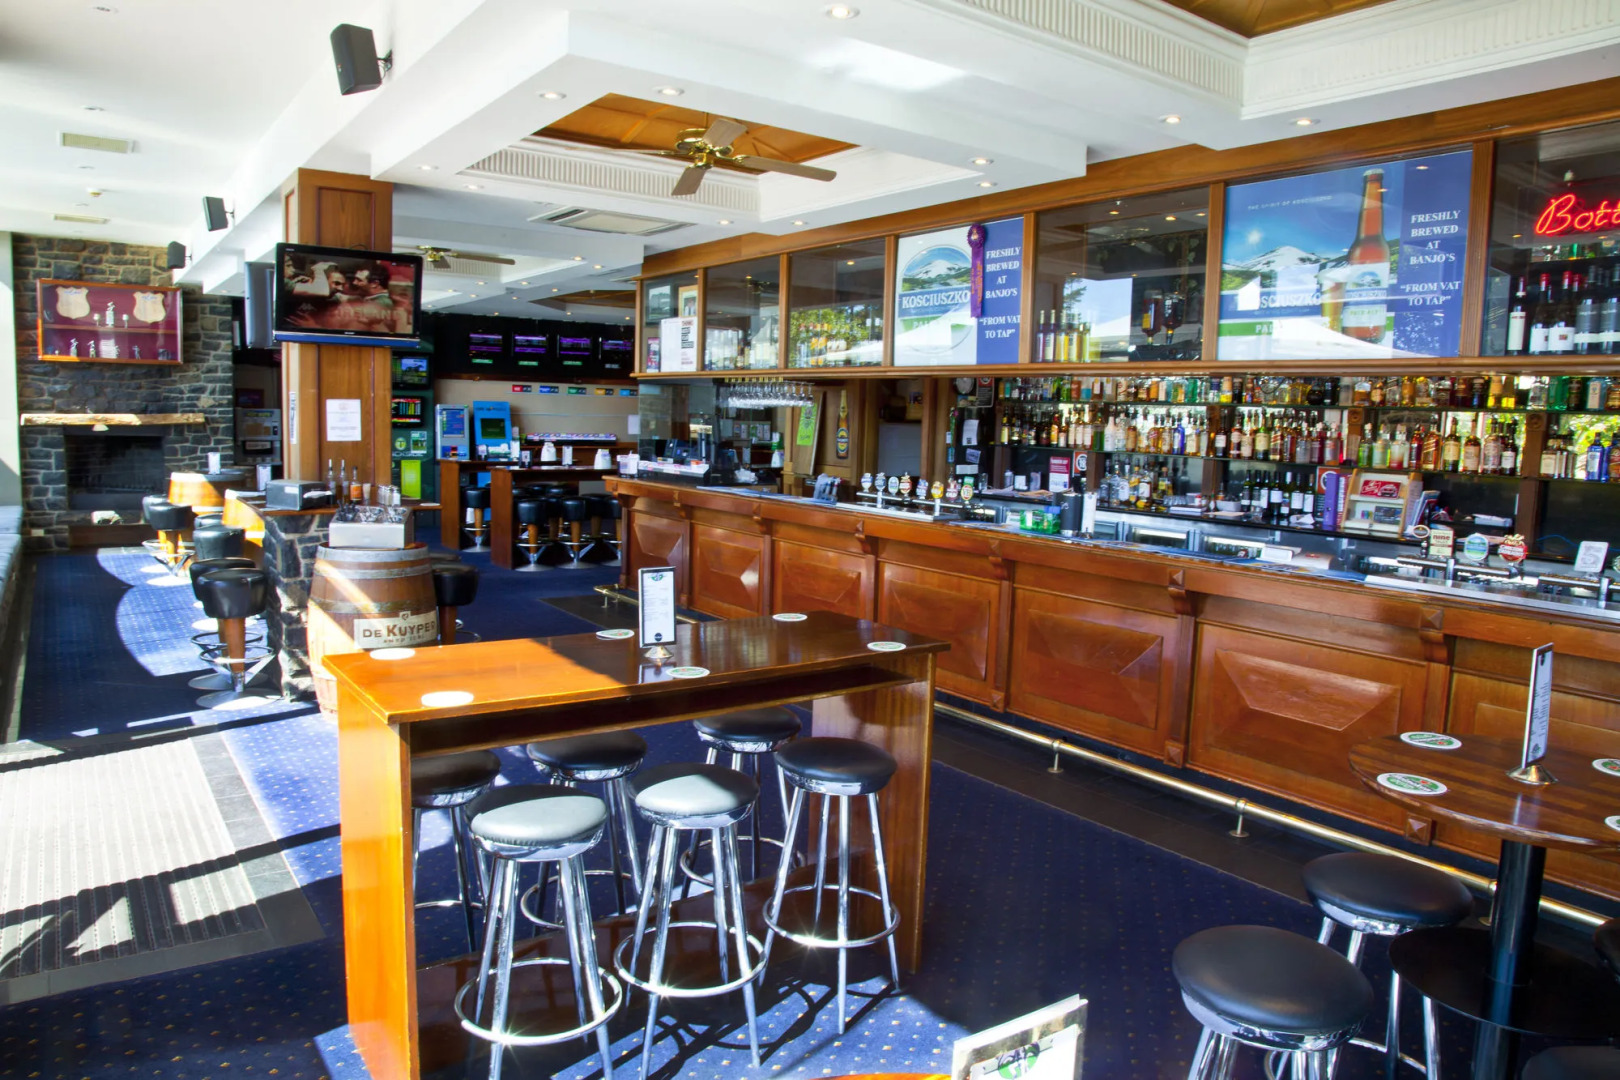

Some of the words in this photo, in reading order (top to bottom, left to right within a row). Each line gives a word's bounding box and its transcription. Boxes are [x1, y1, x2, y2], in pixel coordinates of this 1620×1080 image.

[1410, 209, 1461, 224] FRESHLY
[1410, 224, 1459, 238] BREWED
[1425, 240, 1441, 250] AT
[986, 246, 1021, 260] FRESHLY
[1409, 253, 1456, 265] BANJO'S
[986, 260, 1020, 273] BREWED
[996, 275, 1007, 285] AT
[1439, 280, 1461, 290] VAT
[901, 289, 971, 309] KOSCIUSZKO
[985, 288, 1018, 299] BANJO'S
[1407, 296, 1423, 307] TO
[1006, 314, 1021, 324] VAT
[984, 329, 997, 339] TO
[362, 628, 382, 638] DE
